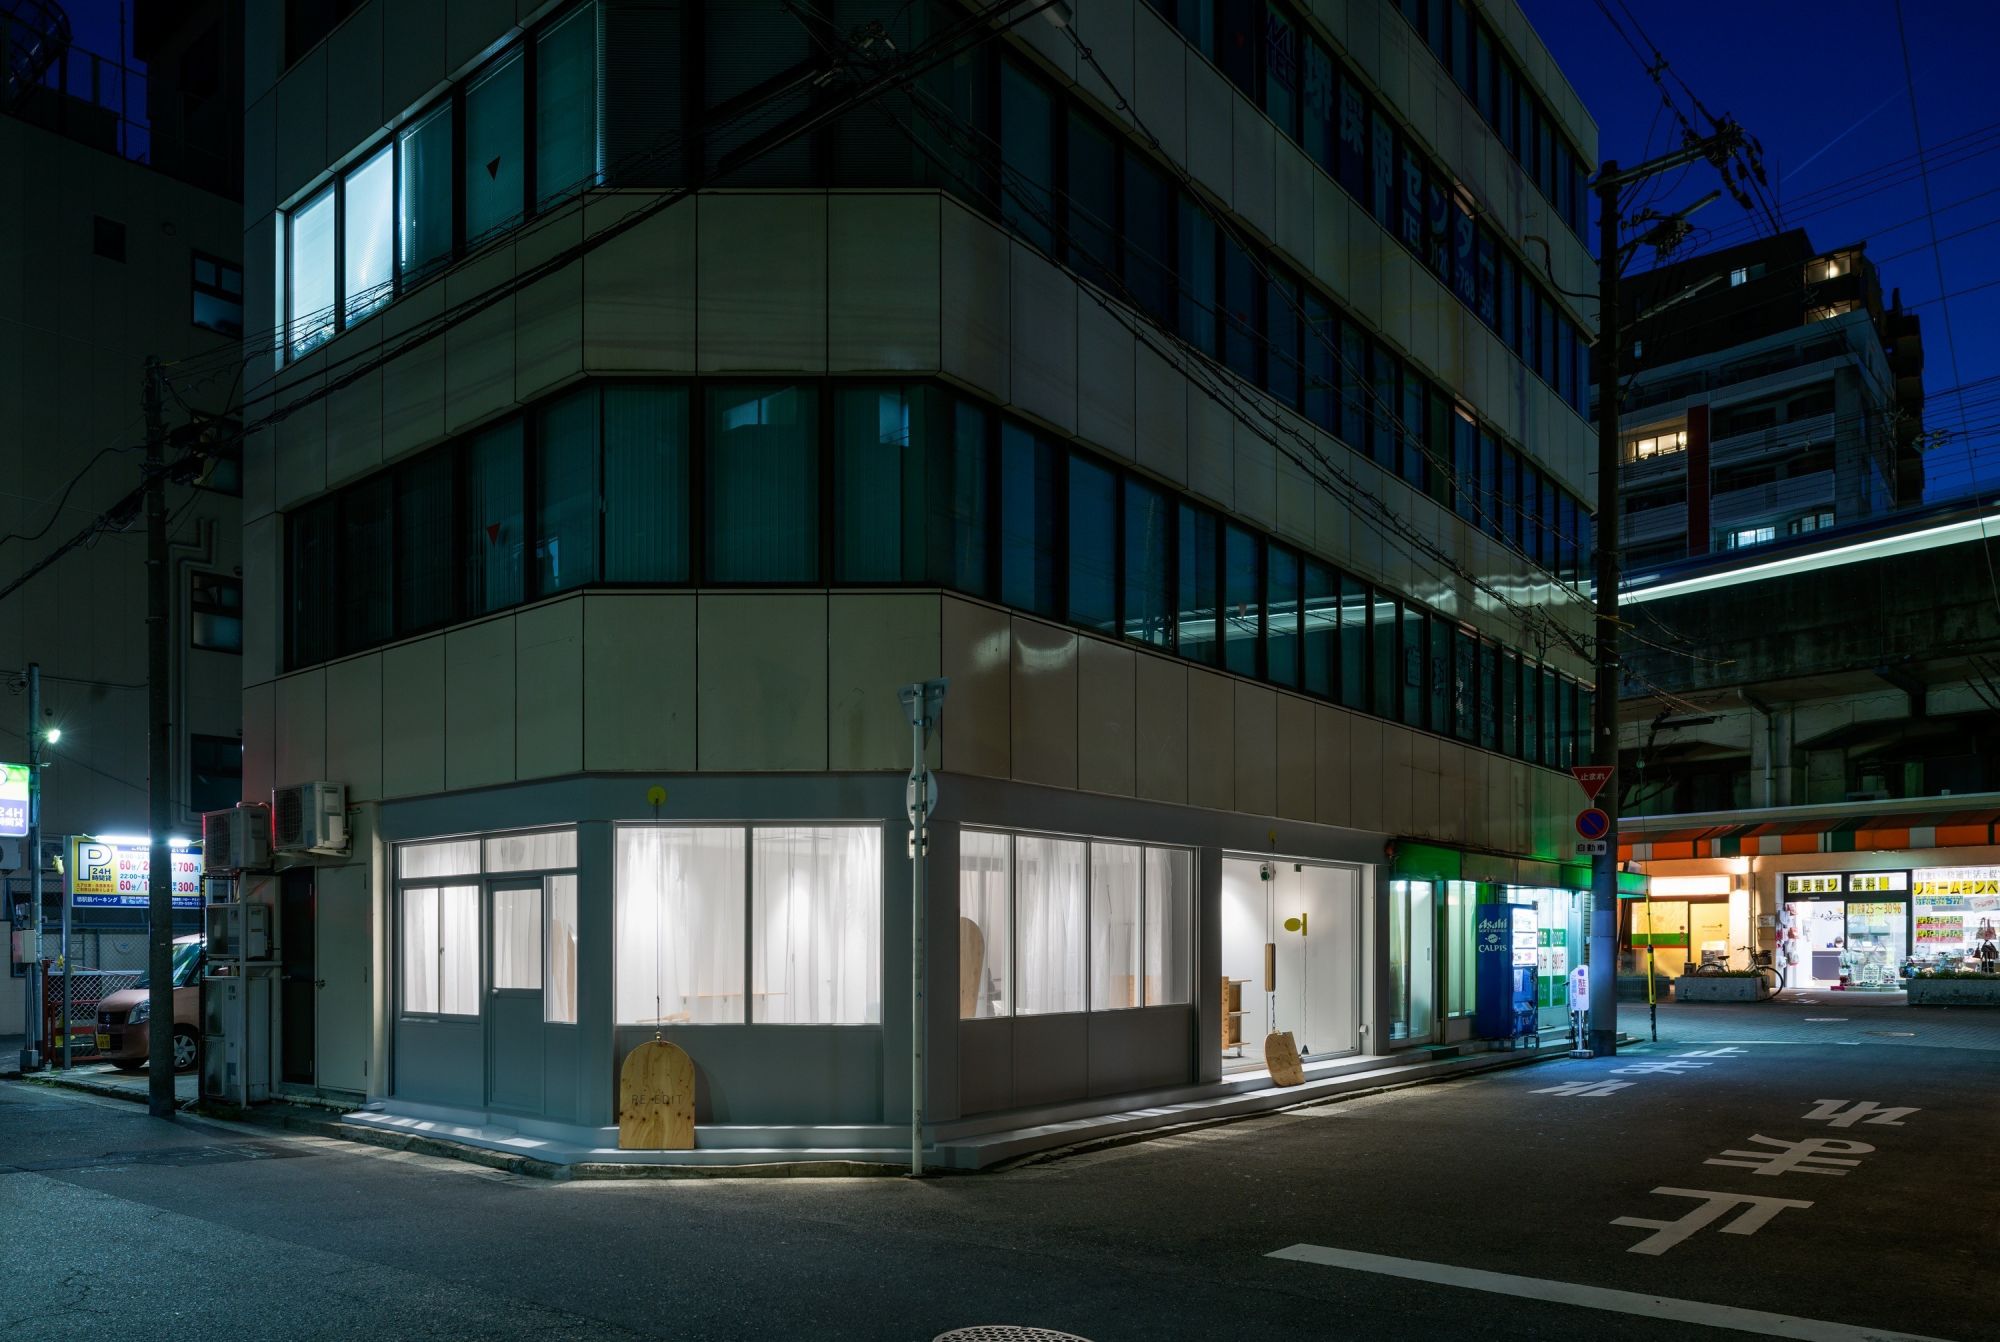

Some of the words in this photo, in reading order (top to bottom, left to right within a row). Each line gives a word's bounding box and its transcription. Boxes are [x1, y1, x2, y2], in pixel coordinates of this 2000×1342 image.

[1401, 210, 1425, 254] TEL
[1580, 772, 1605, 781] 止まれ
[1577, 843, 1605, 852] 自動車
[78, 842, 112, 880] P
[120, 860, 149, 871] 60分/2
[92, 867, 111, 875] 24H
[1788, 878, 1838, 892] 御見積り
[1478, 917, 1508, 929] Asahi
[1478, 944, 1508, 953] CALPIS
[654, 1094, 683, 1105] EDIT
